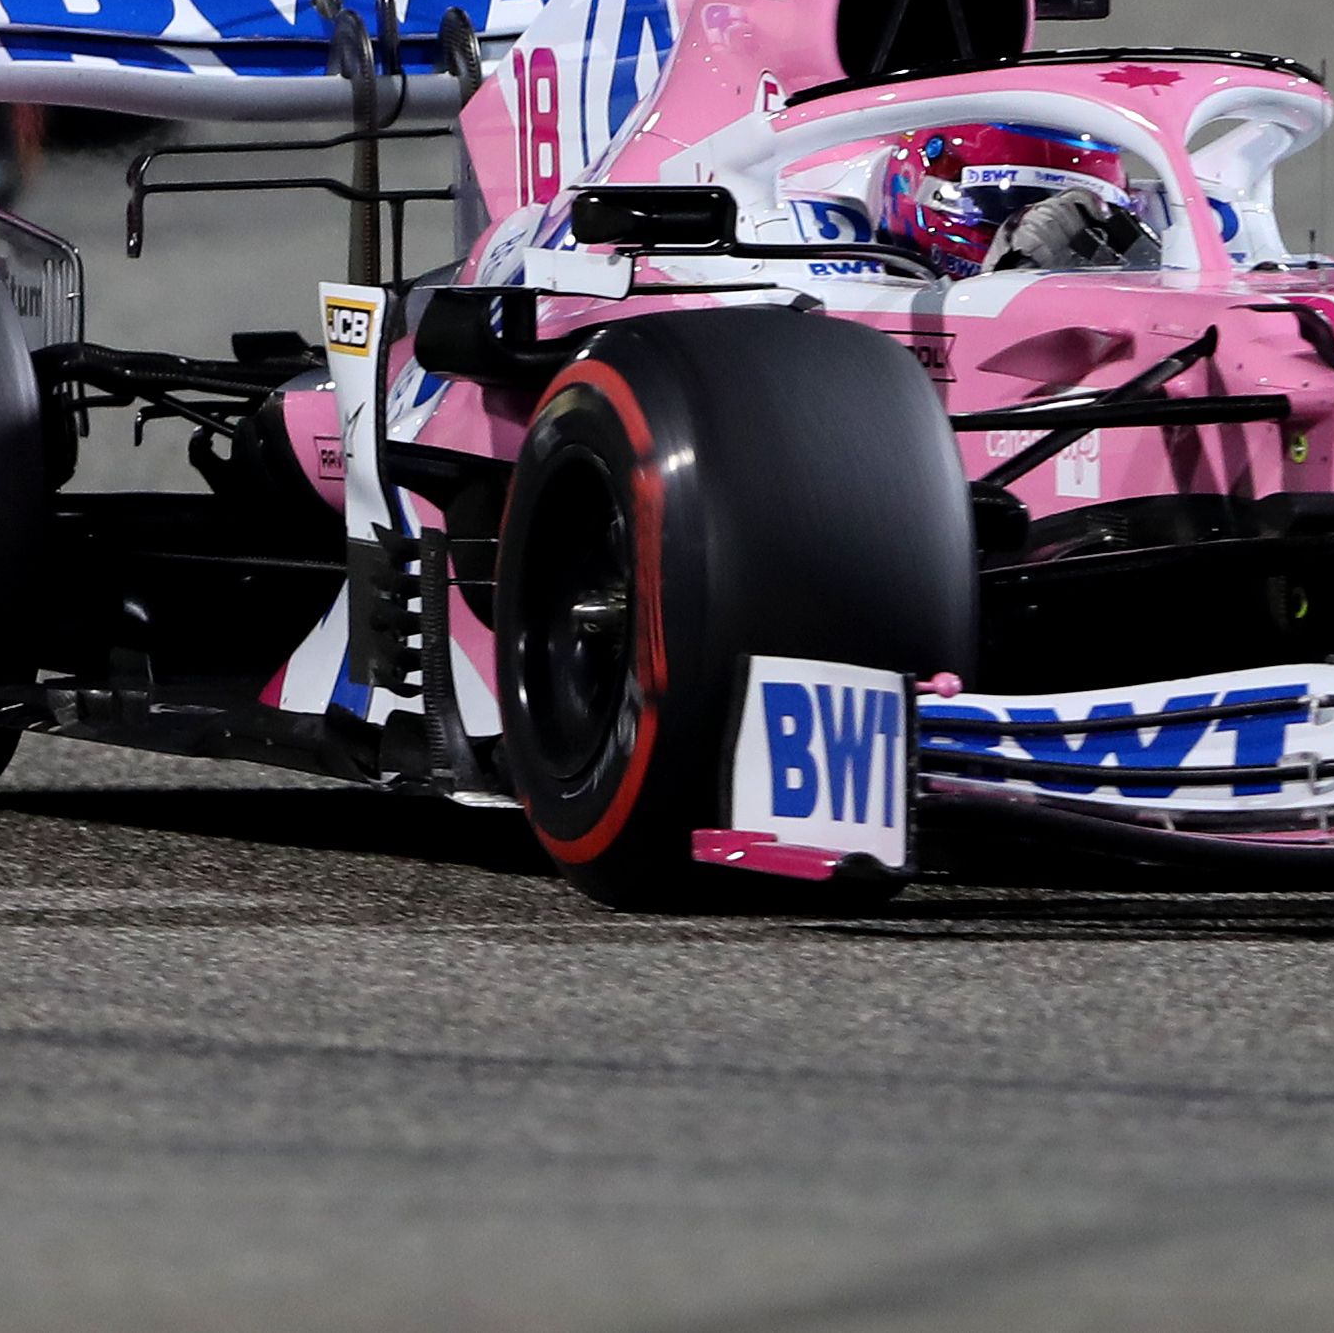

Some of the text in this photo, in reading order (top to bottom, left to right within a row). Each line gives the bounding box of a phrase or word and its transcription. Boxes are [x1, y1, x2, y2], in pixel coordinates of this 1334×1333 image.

[512, 47, 561, 207] 18
[807, 260, 882, 278] BWT
[327, 308, 370, 345] JCB
[760, 682, 903, 829] BWT
